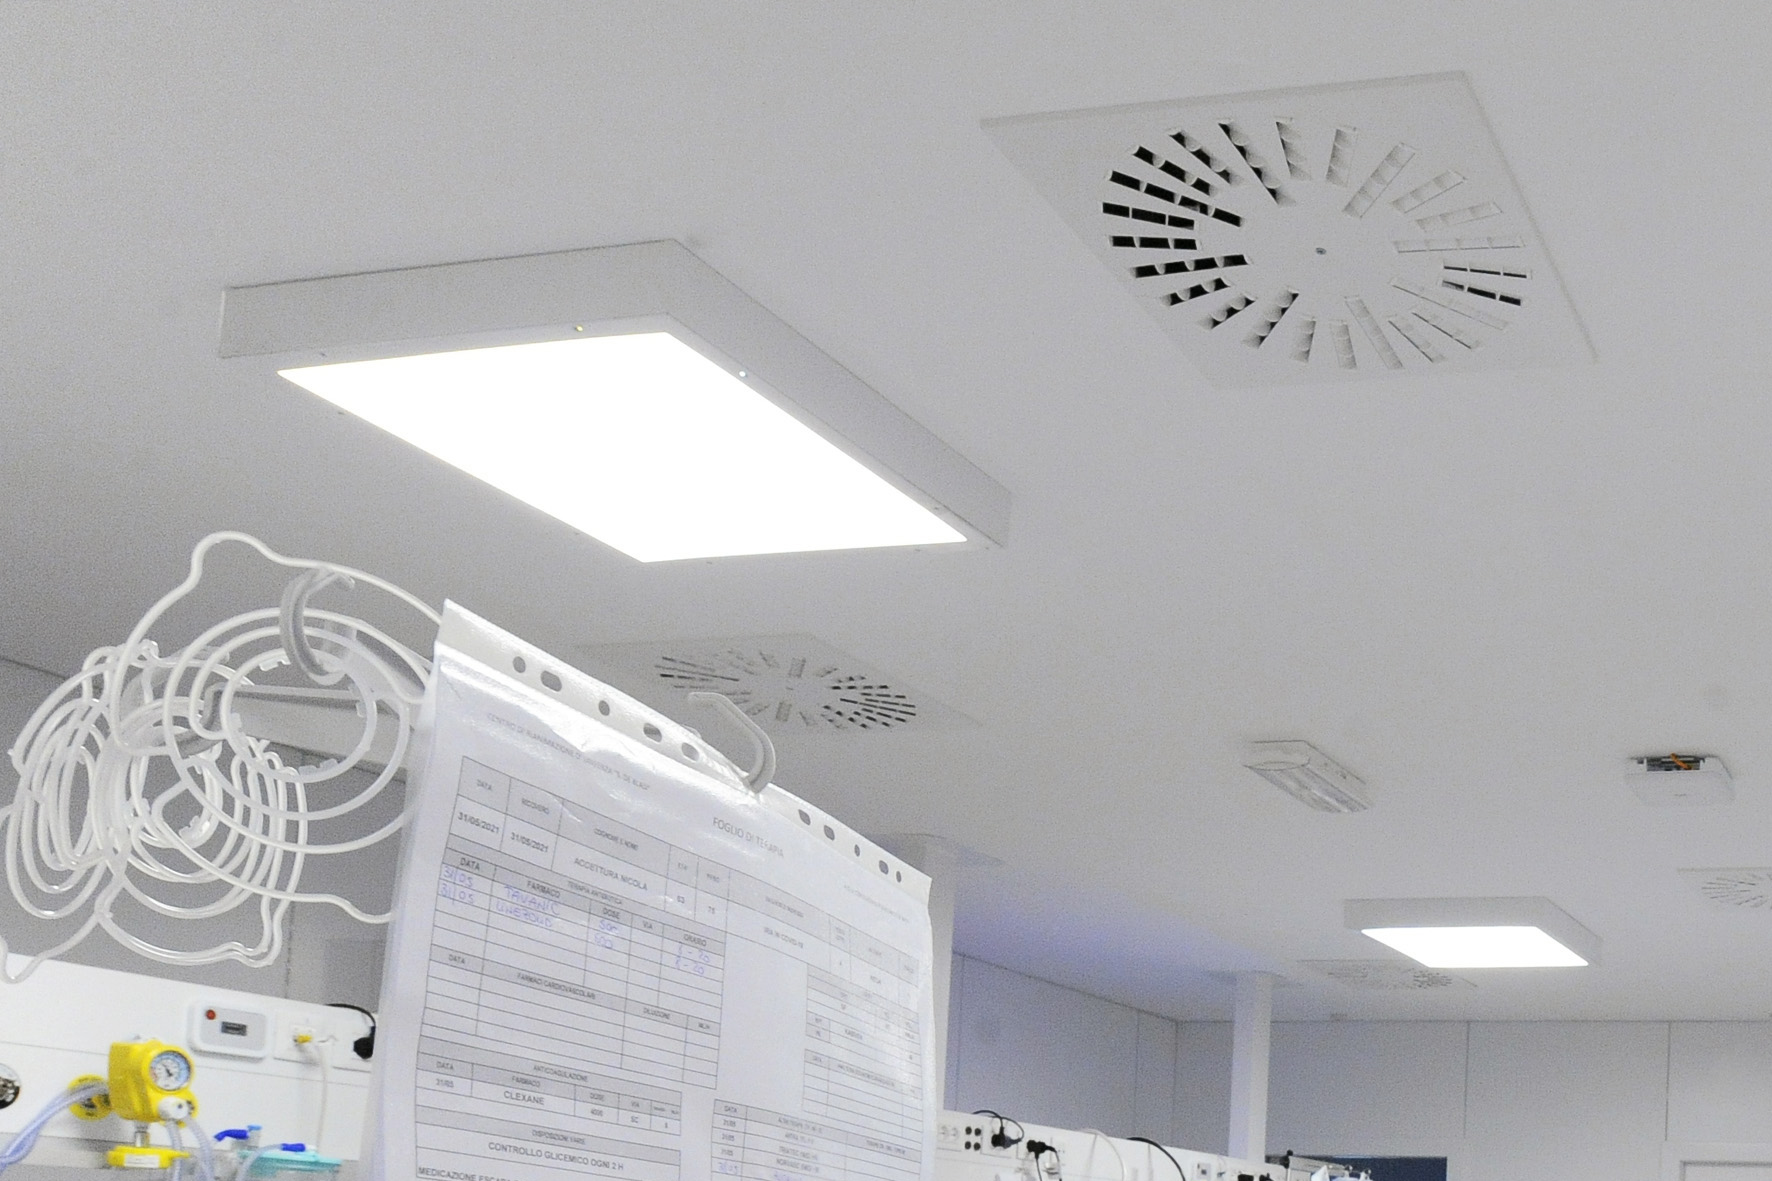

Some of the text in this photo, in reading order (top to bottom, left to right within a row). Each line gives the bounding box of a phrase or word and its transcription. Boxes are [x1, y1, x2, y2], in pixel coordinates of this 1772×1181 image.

[458, 809, 499, 835] 31/05/2021
[511, 830, 547, 854] 31/05/2021
[712, 816, 784, 858] FOGLIO DI TERAPIA
[460, 855, 480, 873] DATA
[527, 878, 560, 900] FARMACO
[603, 906, 620, 921] DOSE
[436, 1061, 540, 1088] DATA FARMACO
[503, 1090, 544, 1105] CLEXANE
[488, 1140, 542, 1158] CONTROLLO
[544, 1149, 589, 1166] GLICEMICO
[590, 1157, 609, 1169] OGNI
